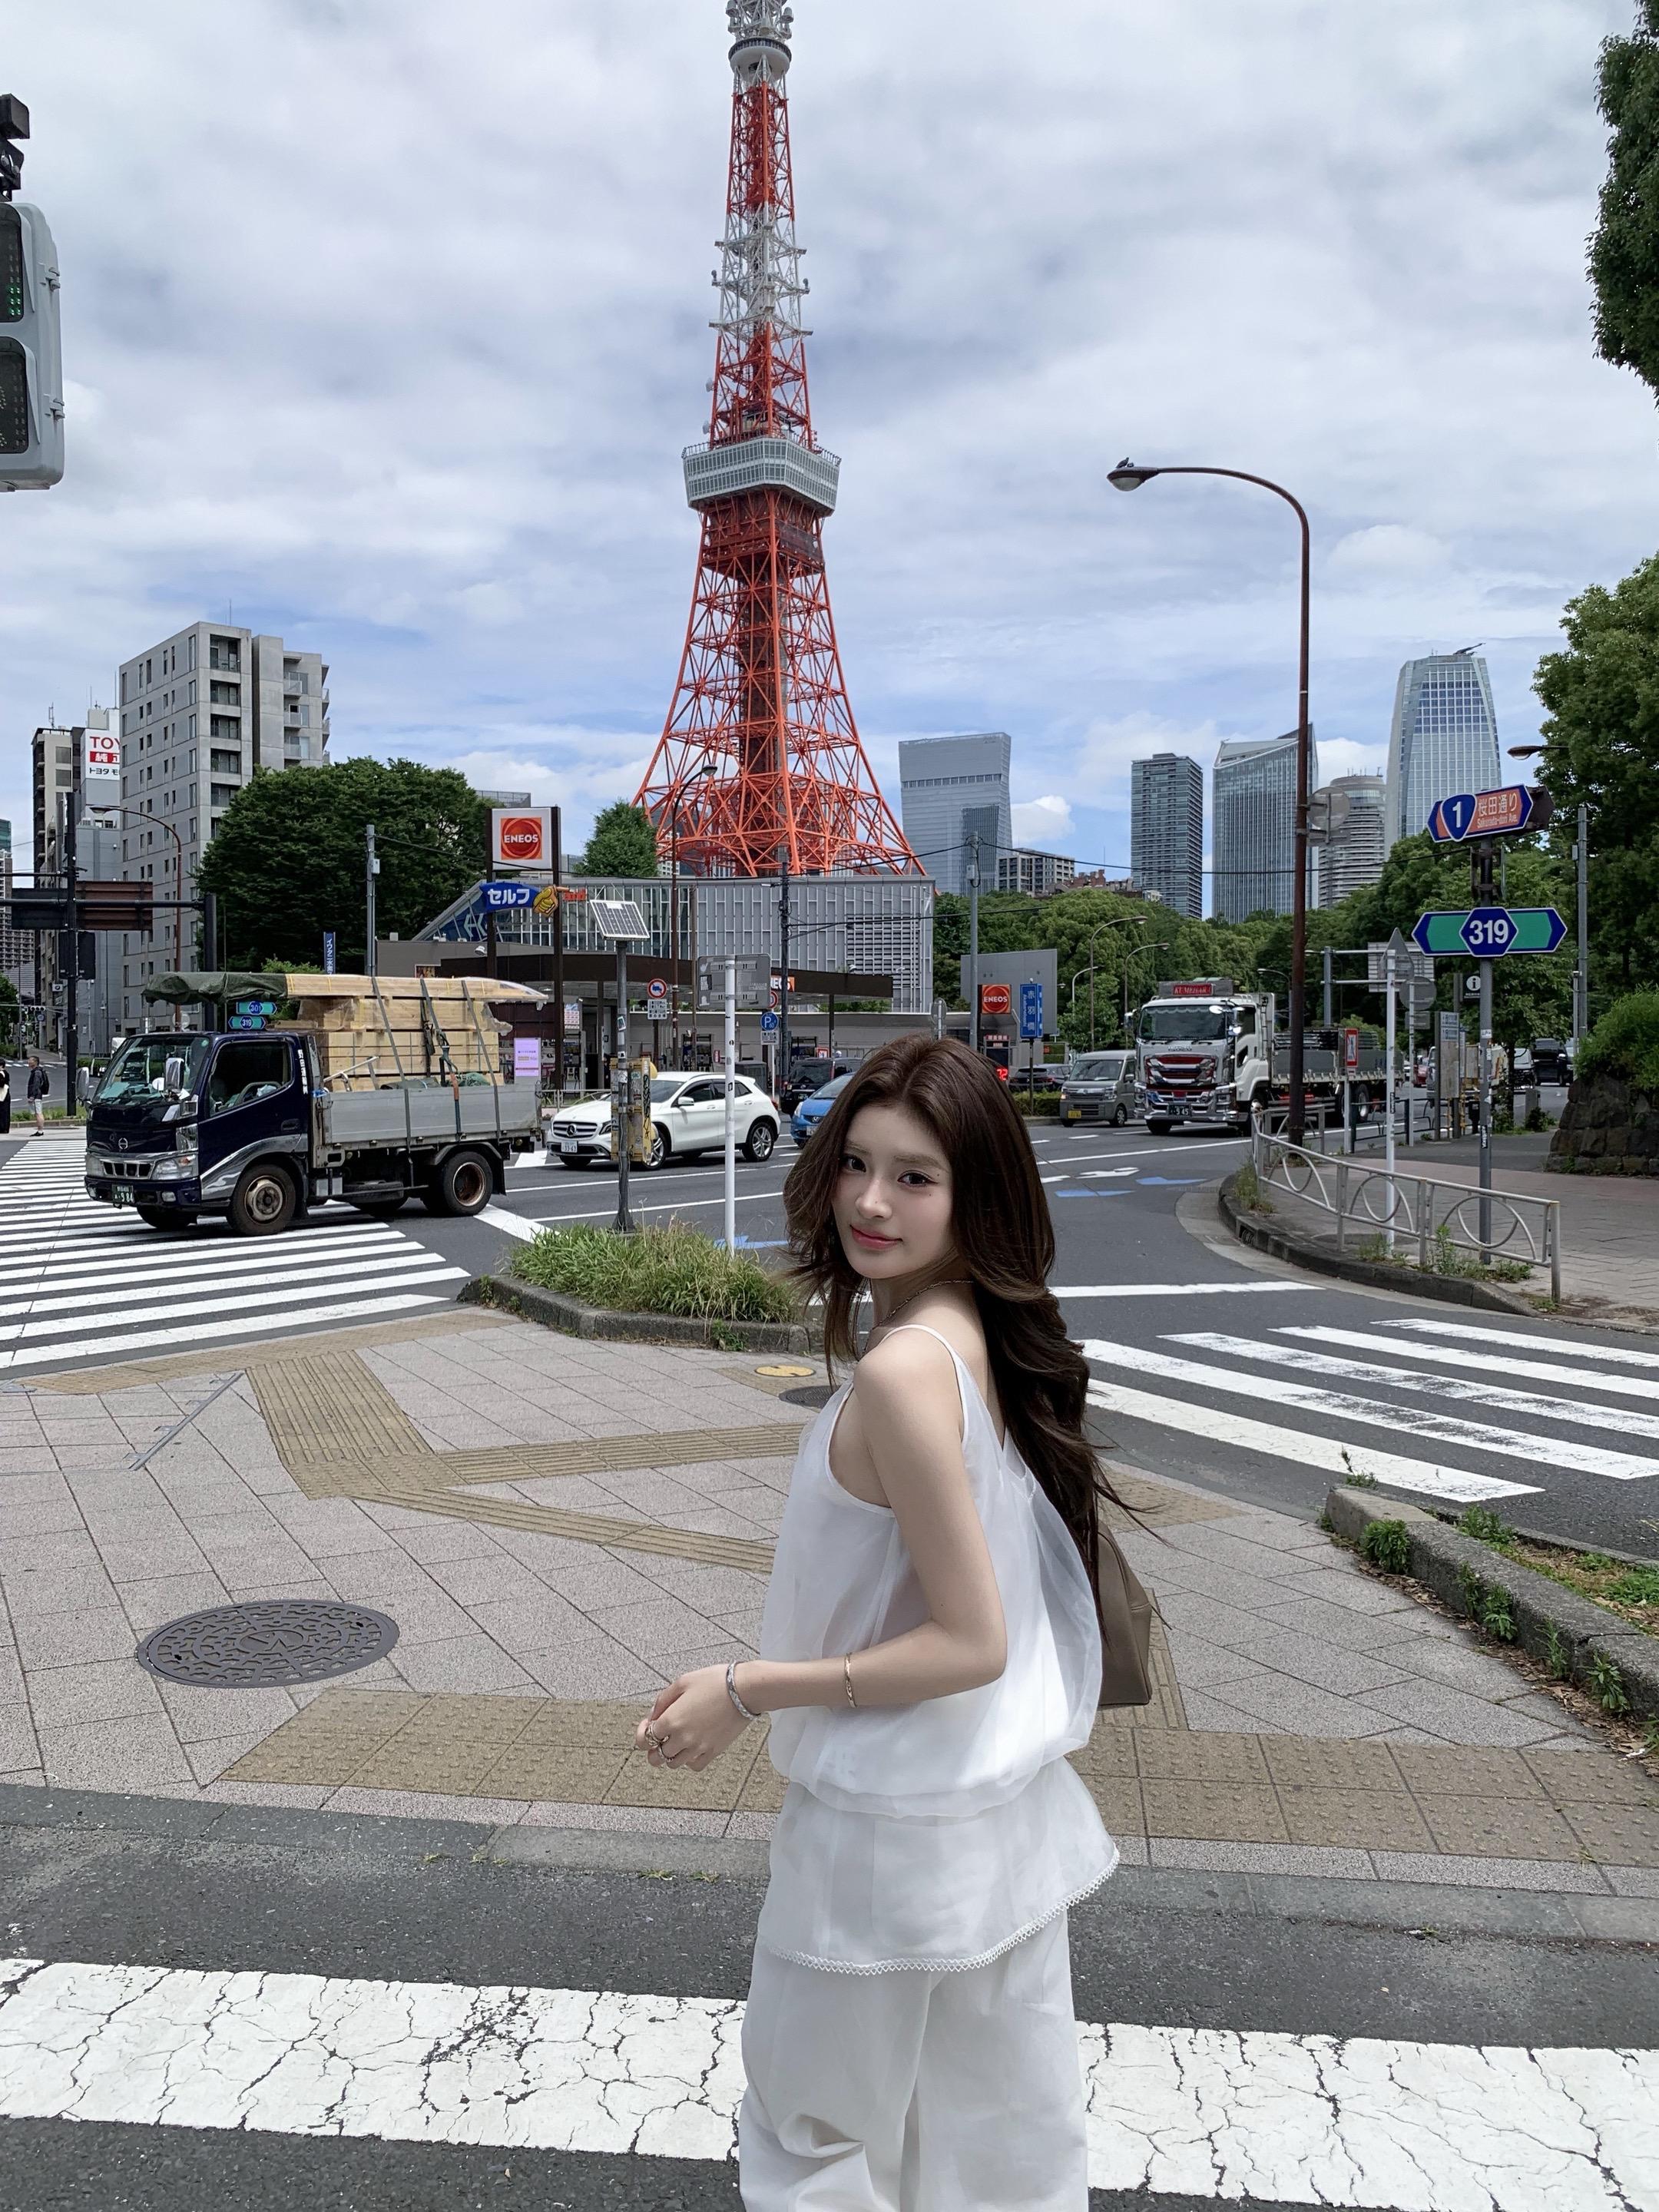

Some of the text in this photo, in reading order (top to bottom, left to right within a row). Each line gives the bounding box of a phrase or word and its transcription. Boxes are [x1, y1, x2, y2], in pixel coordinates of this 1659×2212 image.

[1478, 792, 1518, 817] 桜田通り
[1452, 801, 1462, 828] 1
[1477, 815, 1508, 829] Sakurada-dori
[504, 834, 538, 843] ENEOS
[488, 889, 530, 905] セルフ
[1469, 919, 1509, 945] 319
[242, 1018, 252, 1027] 319
